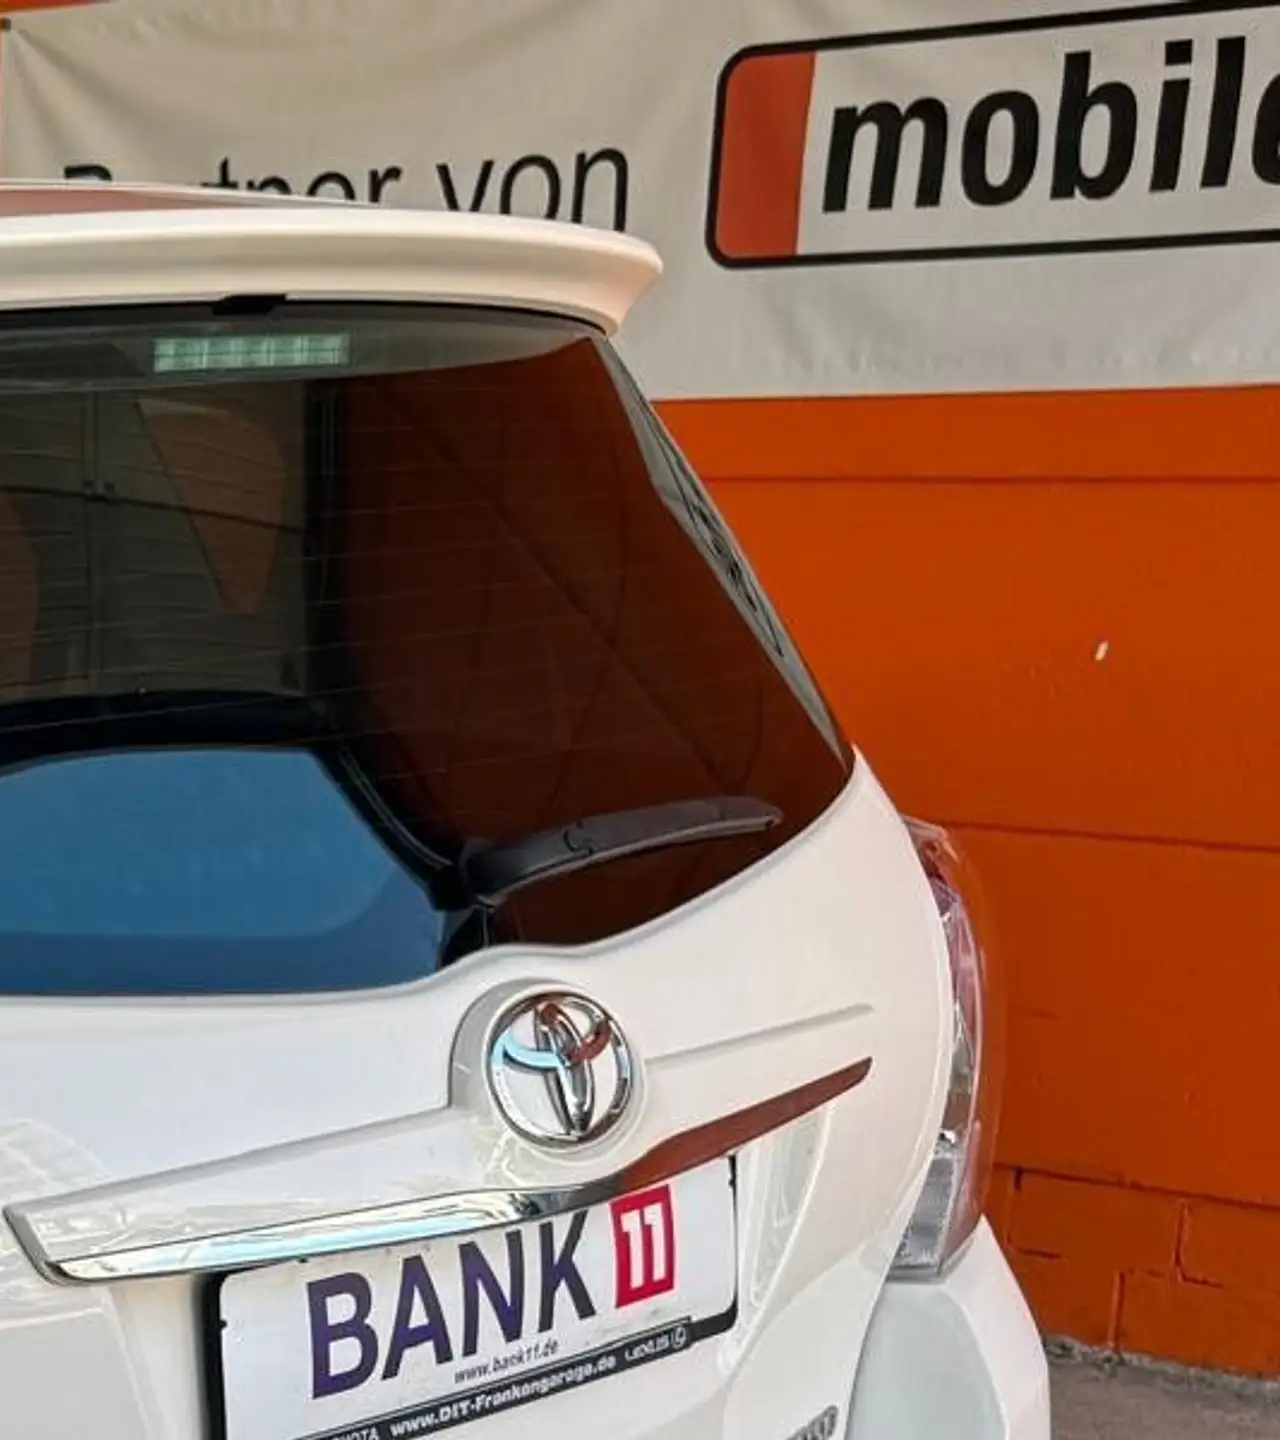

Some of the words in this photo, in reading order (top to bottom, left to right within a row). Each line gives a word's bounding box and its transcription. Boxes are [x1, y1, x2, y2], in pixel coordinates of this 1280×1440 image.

[436, 146, 629, 232] von
[305, 1208, 597, 1399] BANK
[619, 1201, 671, 1293] 11
[453, 1337, 559, 1385] www.bank11.de
